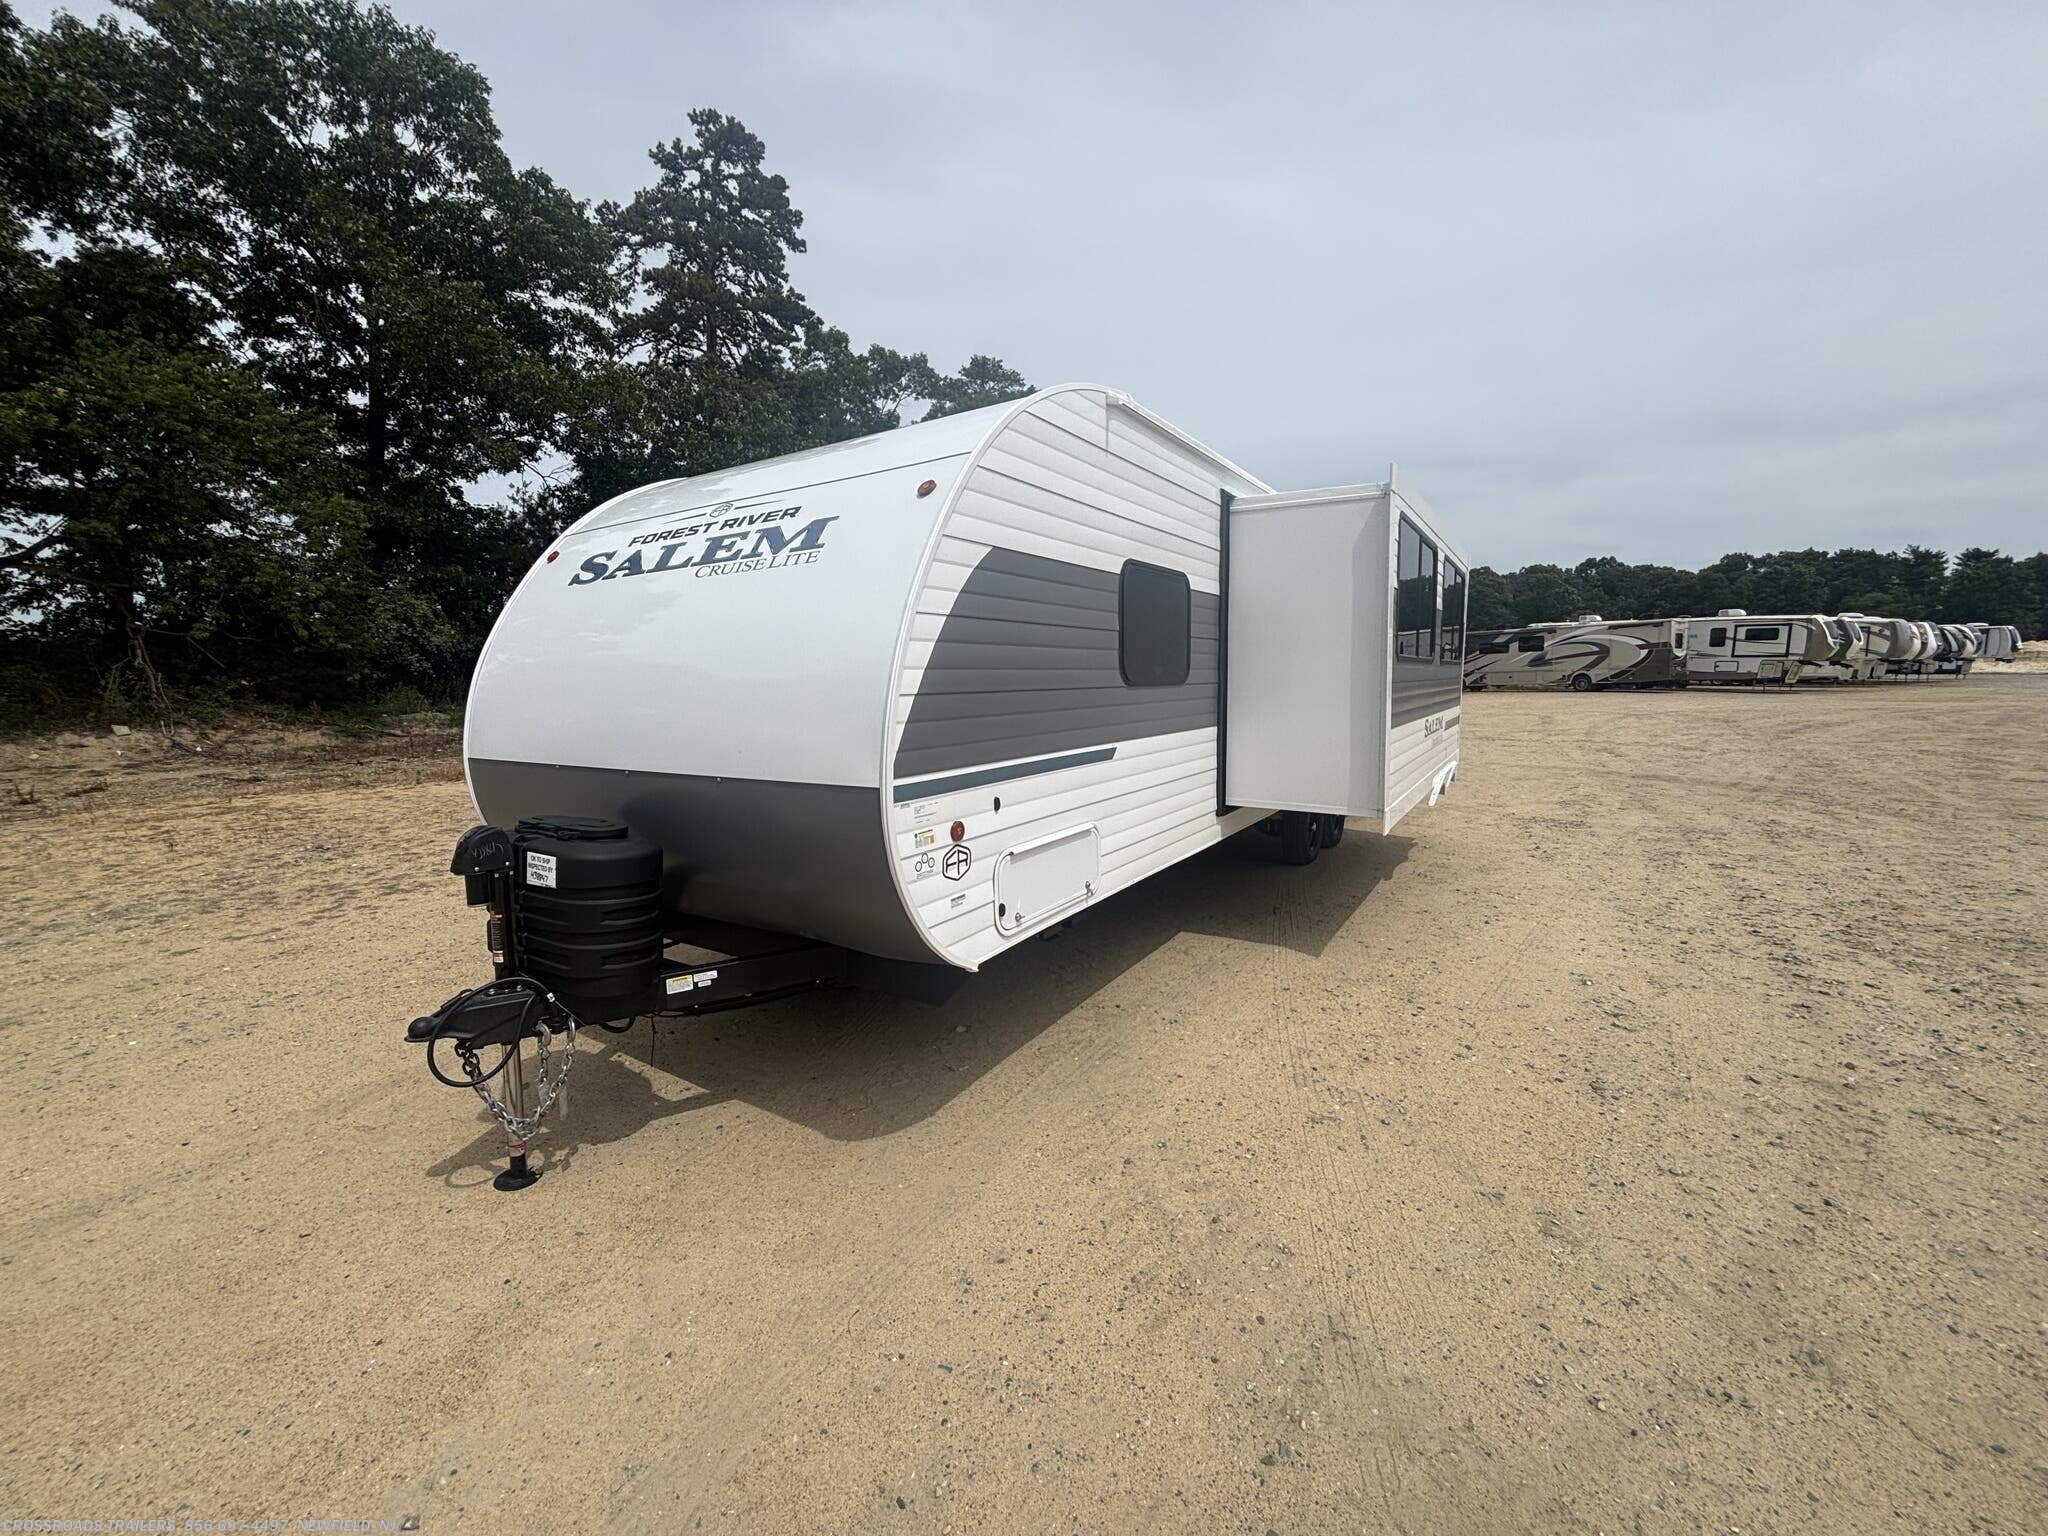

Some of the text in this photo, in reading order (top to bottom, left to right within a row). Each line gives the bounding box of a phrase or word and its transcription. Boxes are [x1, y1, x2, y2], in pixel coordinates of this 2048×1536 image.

[567, 515, 840, 587] SALEM
[627, 506, 802, 548] FOREST RIVER
